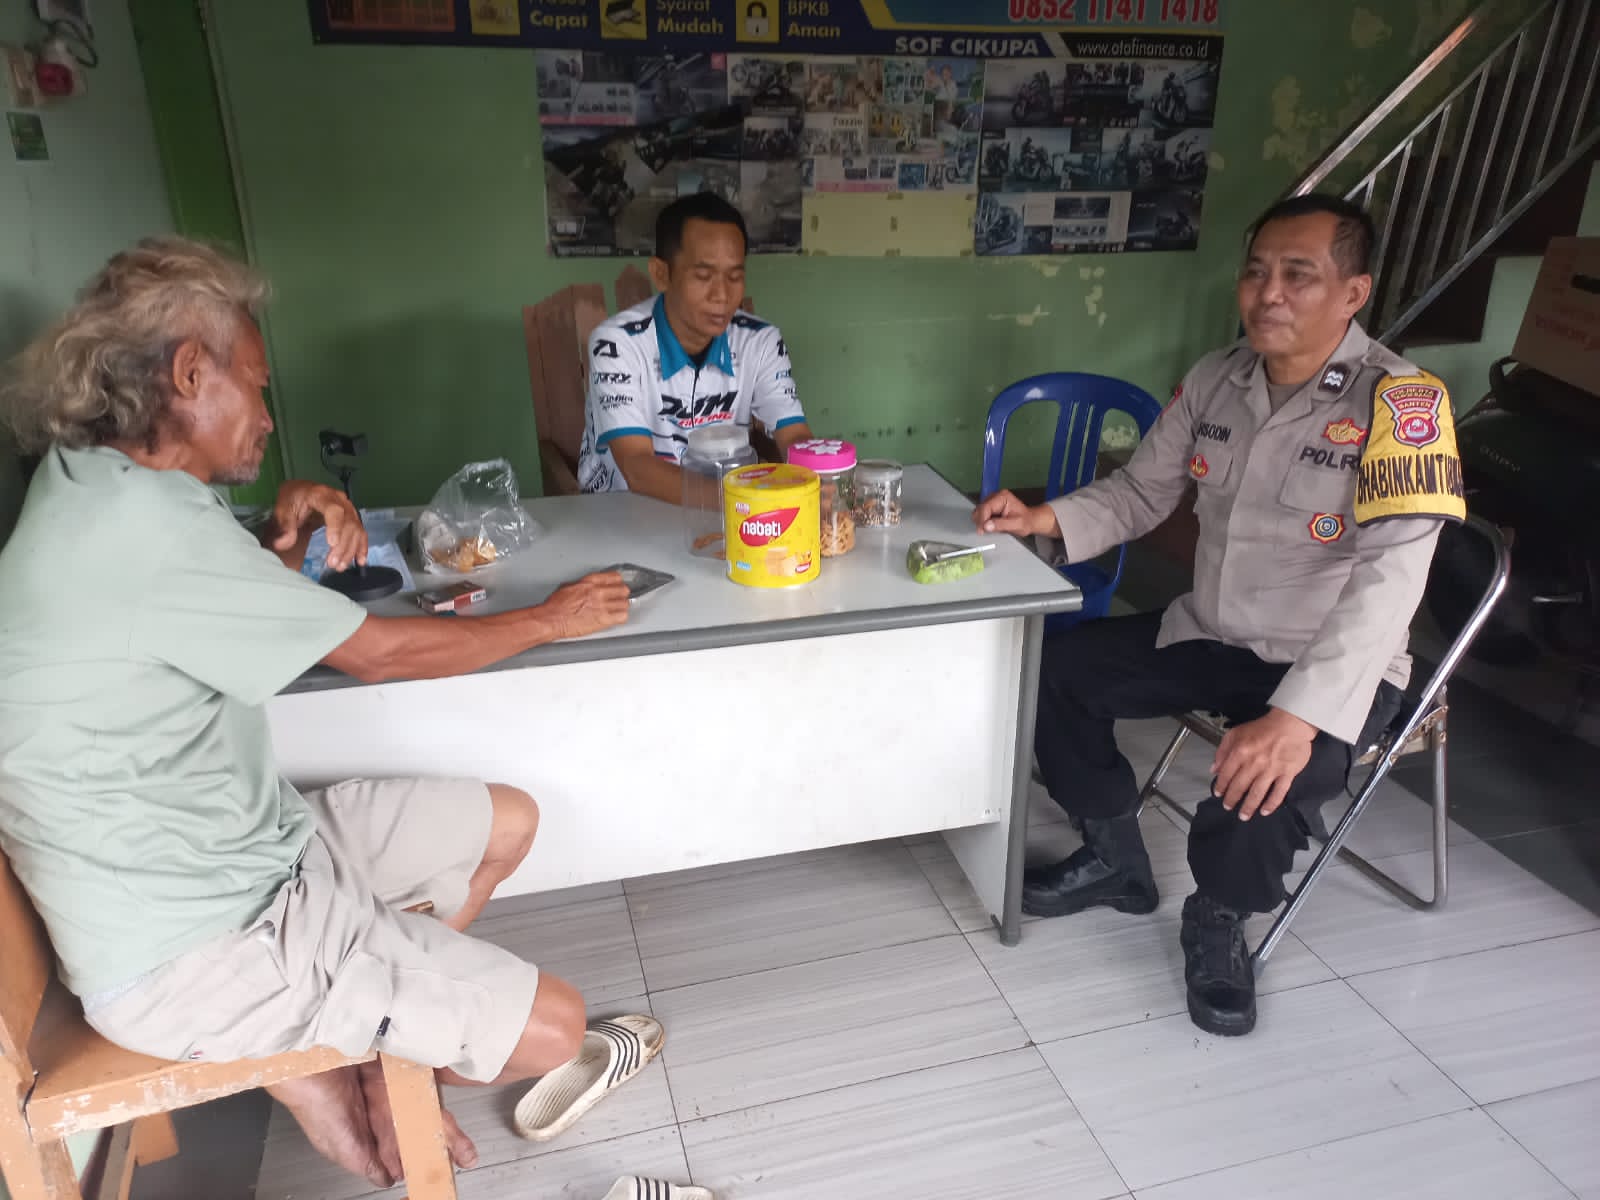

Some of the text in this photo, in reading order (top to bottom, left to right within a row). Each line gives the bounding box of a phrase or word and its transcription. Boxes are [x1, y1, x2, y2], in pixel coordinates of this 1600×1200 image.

[788, 0, 830, 16] BPKB
[529, 9, 589, 31] Cepat
[657, 17, 724, 33] Mudah
[787, 21, 841, 38] Aman
[895, 36, 1040, 57] SOF CIKUPA
[743, 520, 781, 537] nabati
